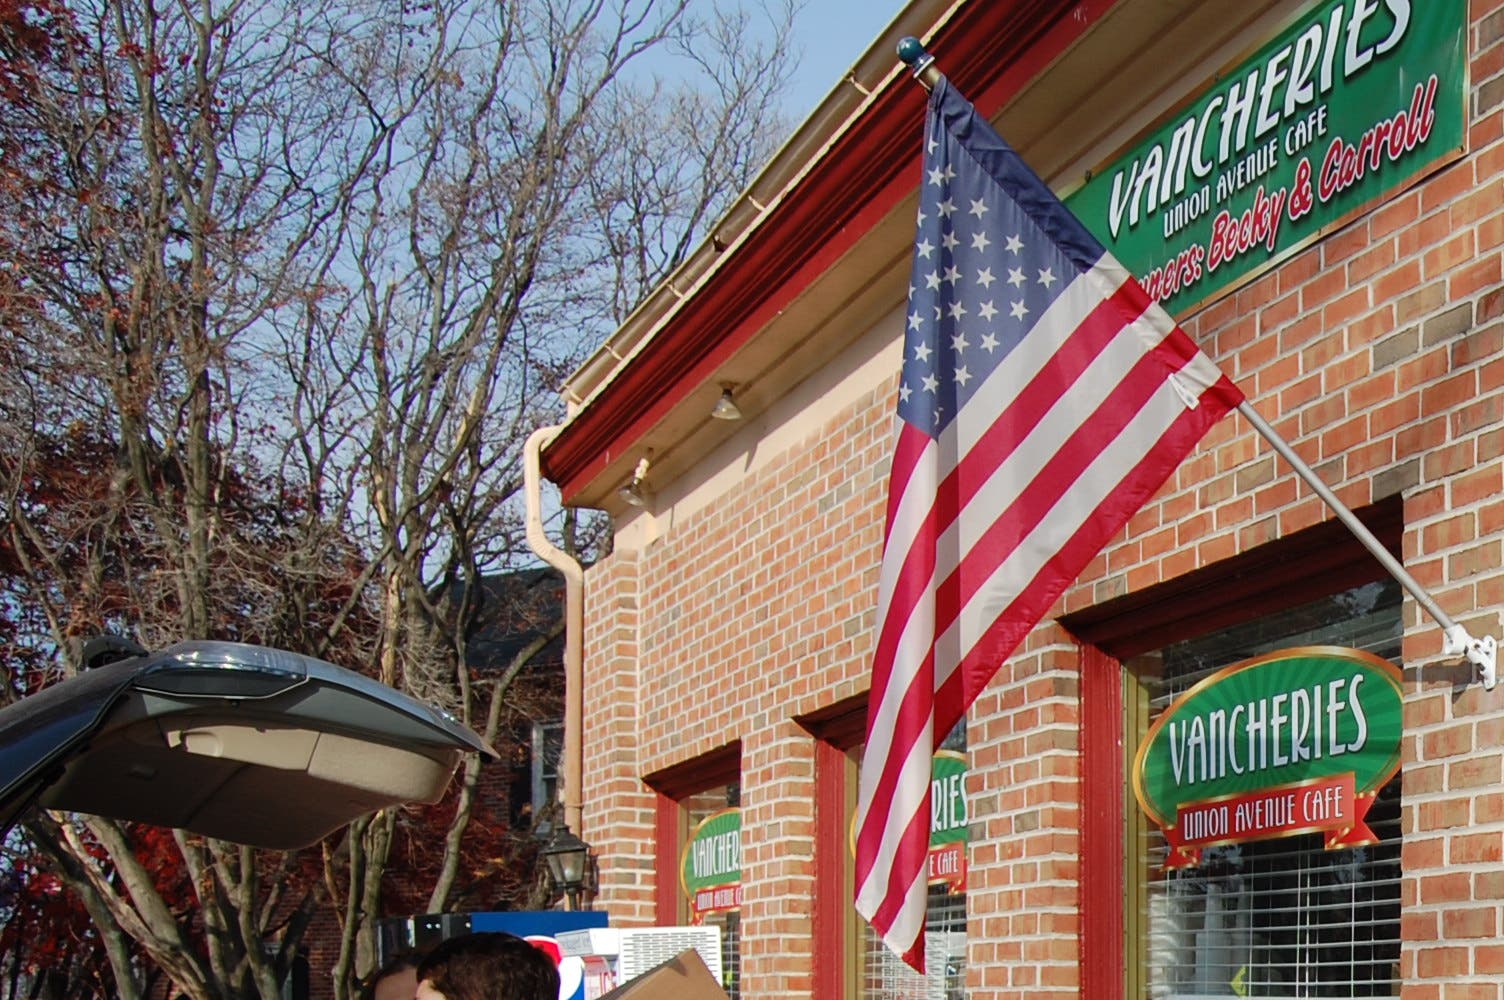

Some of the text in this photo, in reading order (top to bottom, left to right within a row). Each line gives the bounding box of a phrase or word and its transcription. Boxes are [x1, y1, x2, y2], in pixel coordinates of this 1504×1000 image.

[1109, 0, 1411, 238] VANCHERIES
[1163, 105, 1327, 239] UNION AVENUE CAFE
[1207, 184, 1286, 272] Becky
[1288, 157, 1313, 221] &
[1318, 73, 1438, 203] Carroll
[1169, 673, 1368, 787] VANCHERIES
[937, 850, 959, 875] CAFE
[1183, 786, 1344, 841] UNION AVENUE CAFE
